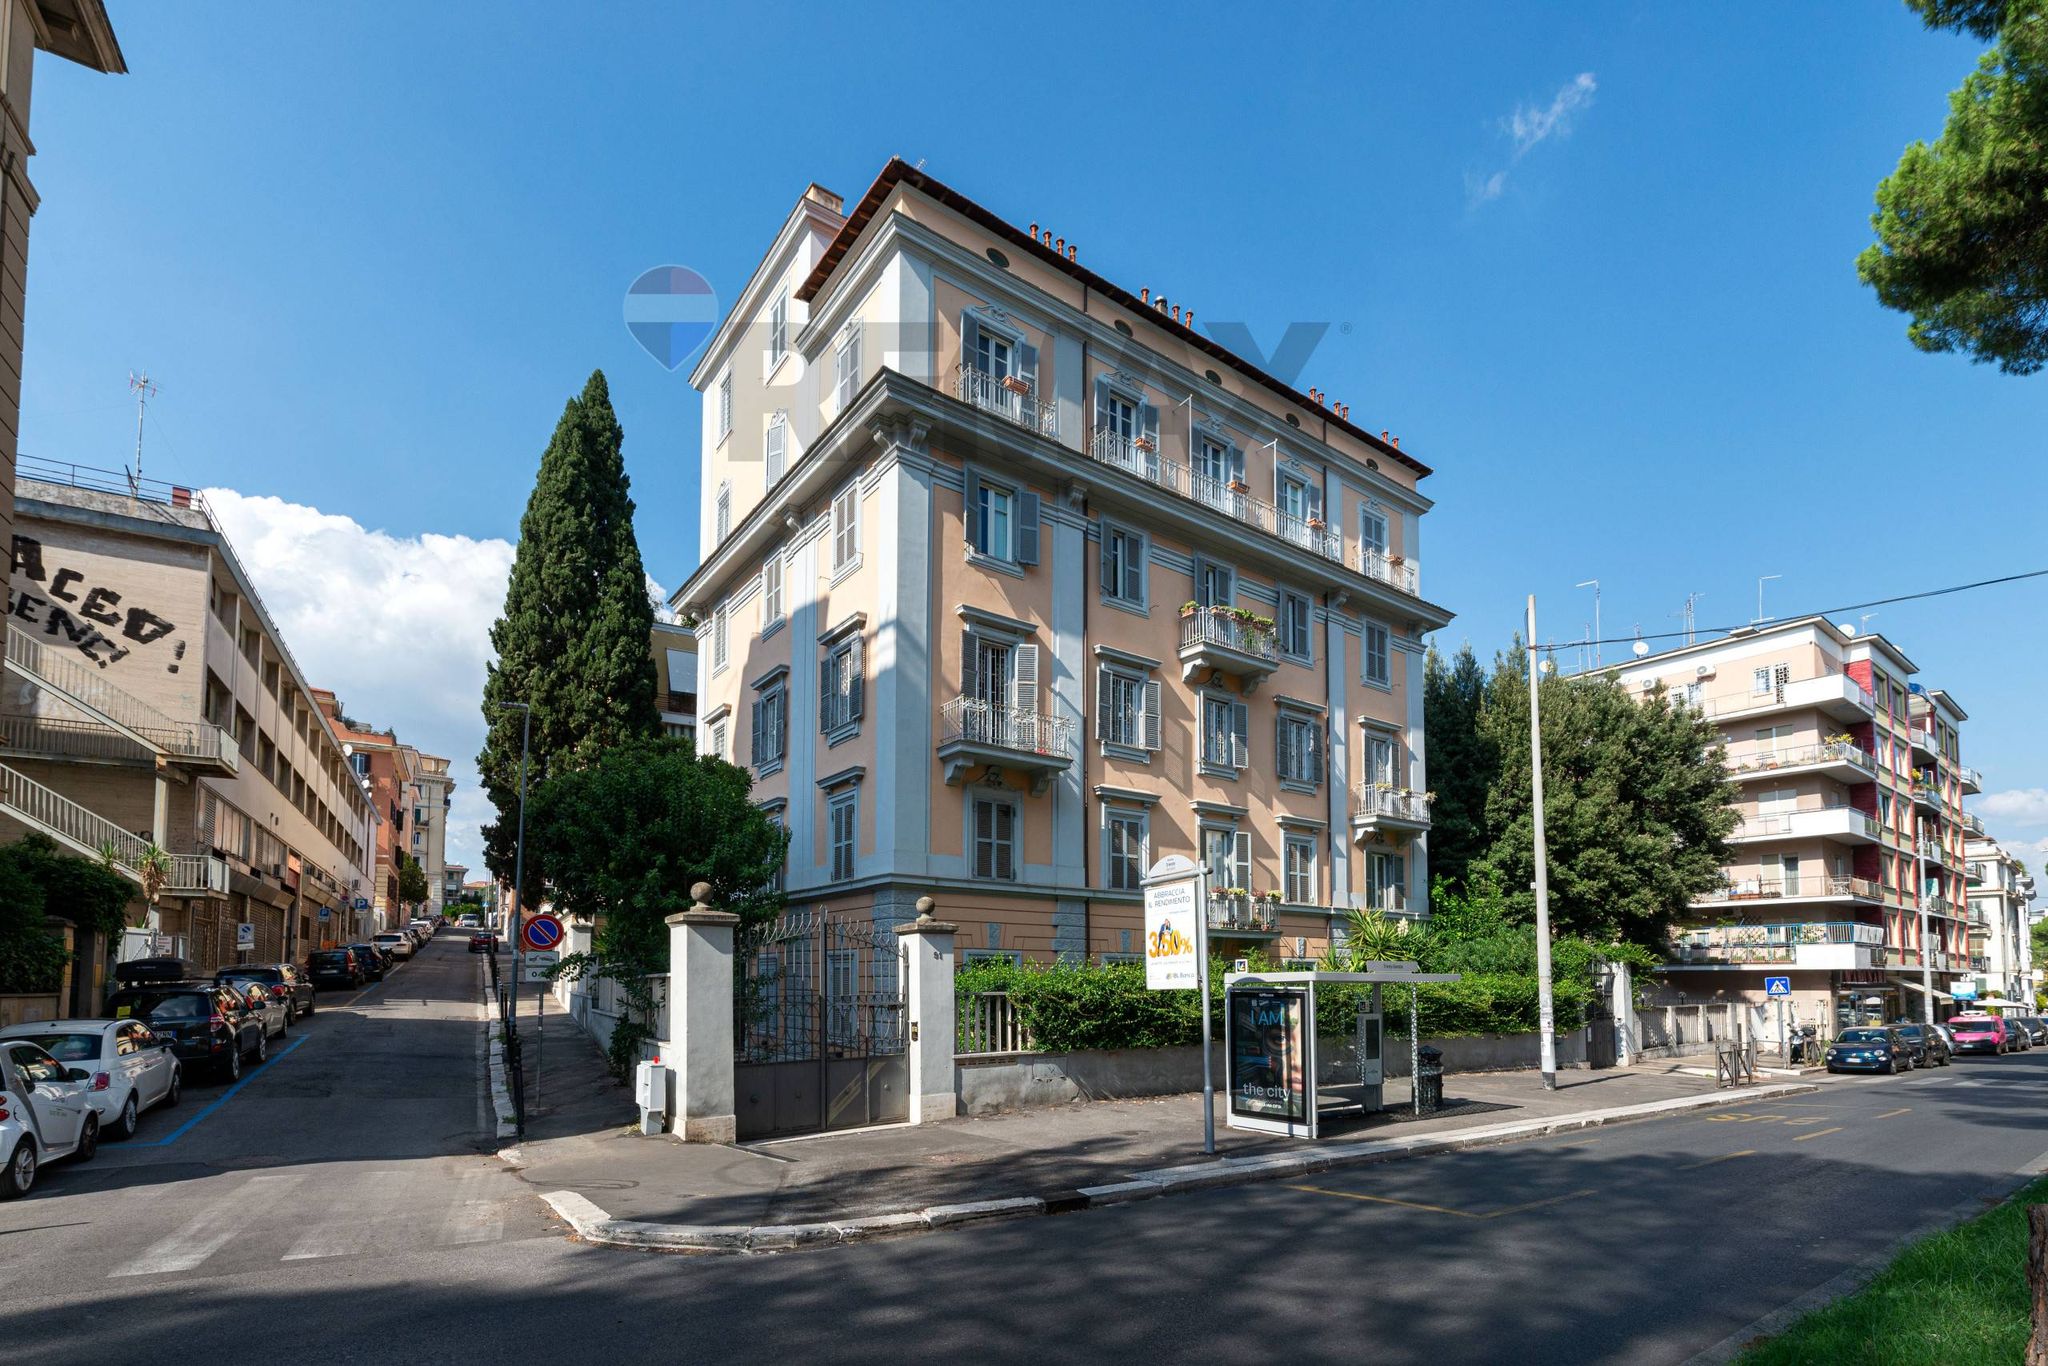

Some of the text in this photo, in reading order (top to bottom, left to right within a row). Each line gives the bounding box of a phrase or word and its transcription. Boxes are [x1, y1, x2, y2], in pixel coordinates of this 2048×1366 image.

[1153, 888, 1185, 899] ABBRACCIA
[1154, 896, 1191, 907] RENDIMENTO
[1258, 1010, 1283, 1026] AM
[1243, 1082, 1291, 1102] the city
